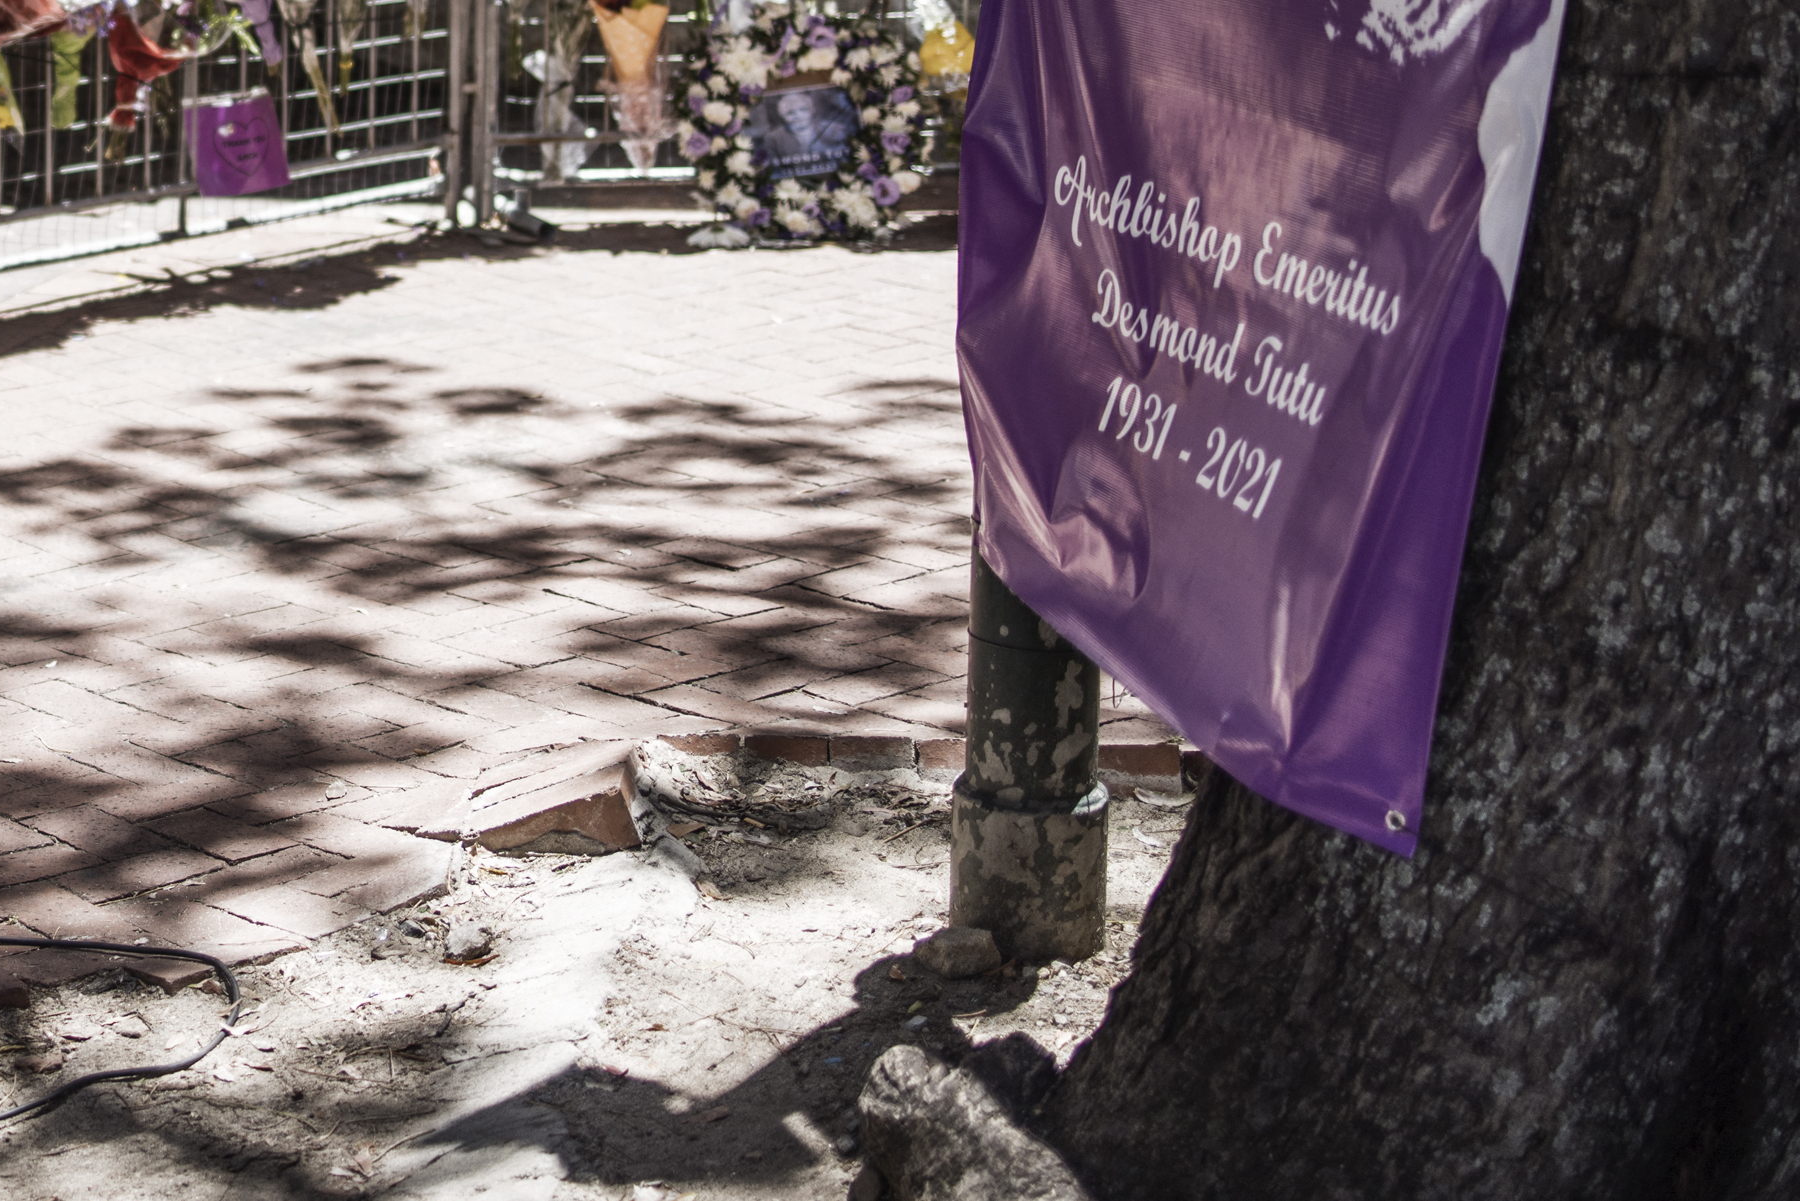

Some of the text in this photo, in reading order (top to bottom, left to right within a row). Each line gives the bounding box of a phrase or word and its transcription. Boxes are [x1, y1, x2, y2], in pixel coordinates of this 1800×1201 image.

[222, 138, 250, 148] THANK
[1054, 155, 1401, 335] Archbishop Emeritus
[1092, 269, 1329, 426] Desmond Tutu
[1098, 376, 1178, 461] 1931
[1196, 427, 1282, 519] 2021
